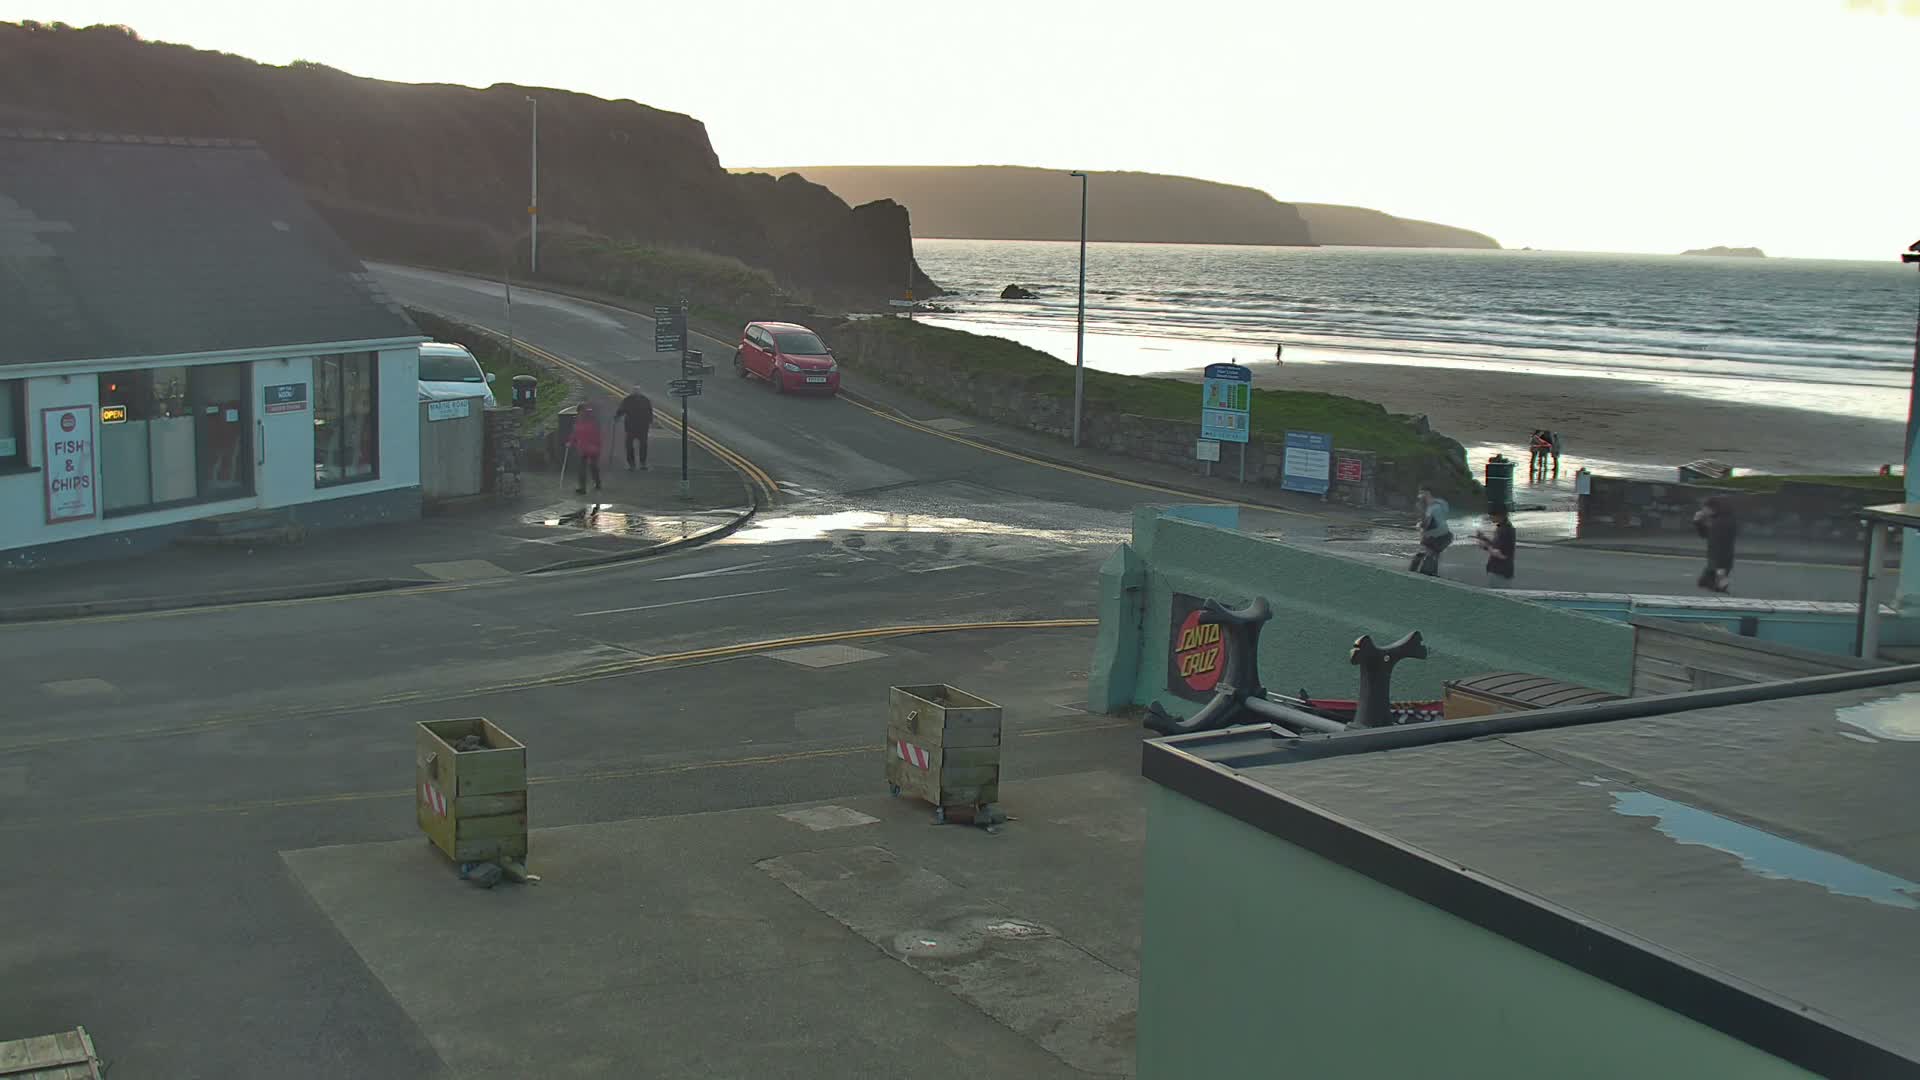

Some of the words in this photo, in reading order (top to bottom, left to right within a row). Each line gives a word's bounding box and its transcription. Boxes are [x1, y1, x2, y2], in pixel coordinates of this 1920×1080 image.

[104, 409, 123, 420] OPEN
[55, 440, 84, 455] FISH
[65, 459, 74, 472] &
[52, 475, 90, 492] CHIPS
[1175, 624, 1219, 652] SANTA
[1181, 648, 1218, 676] CRUZ
